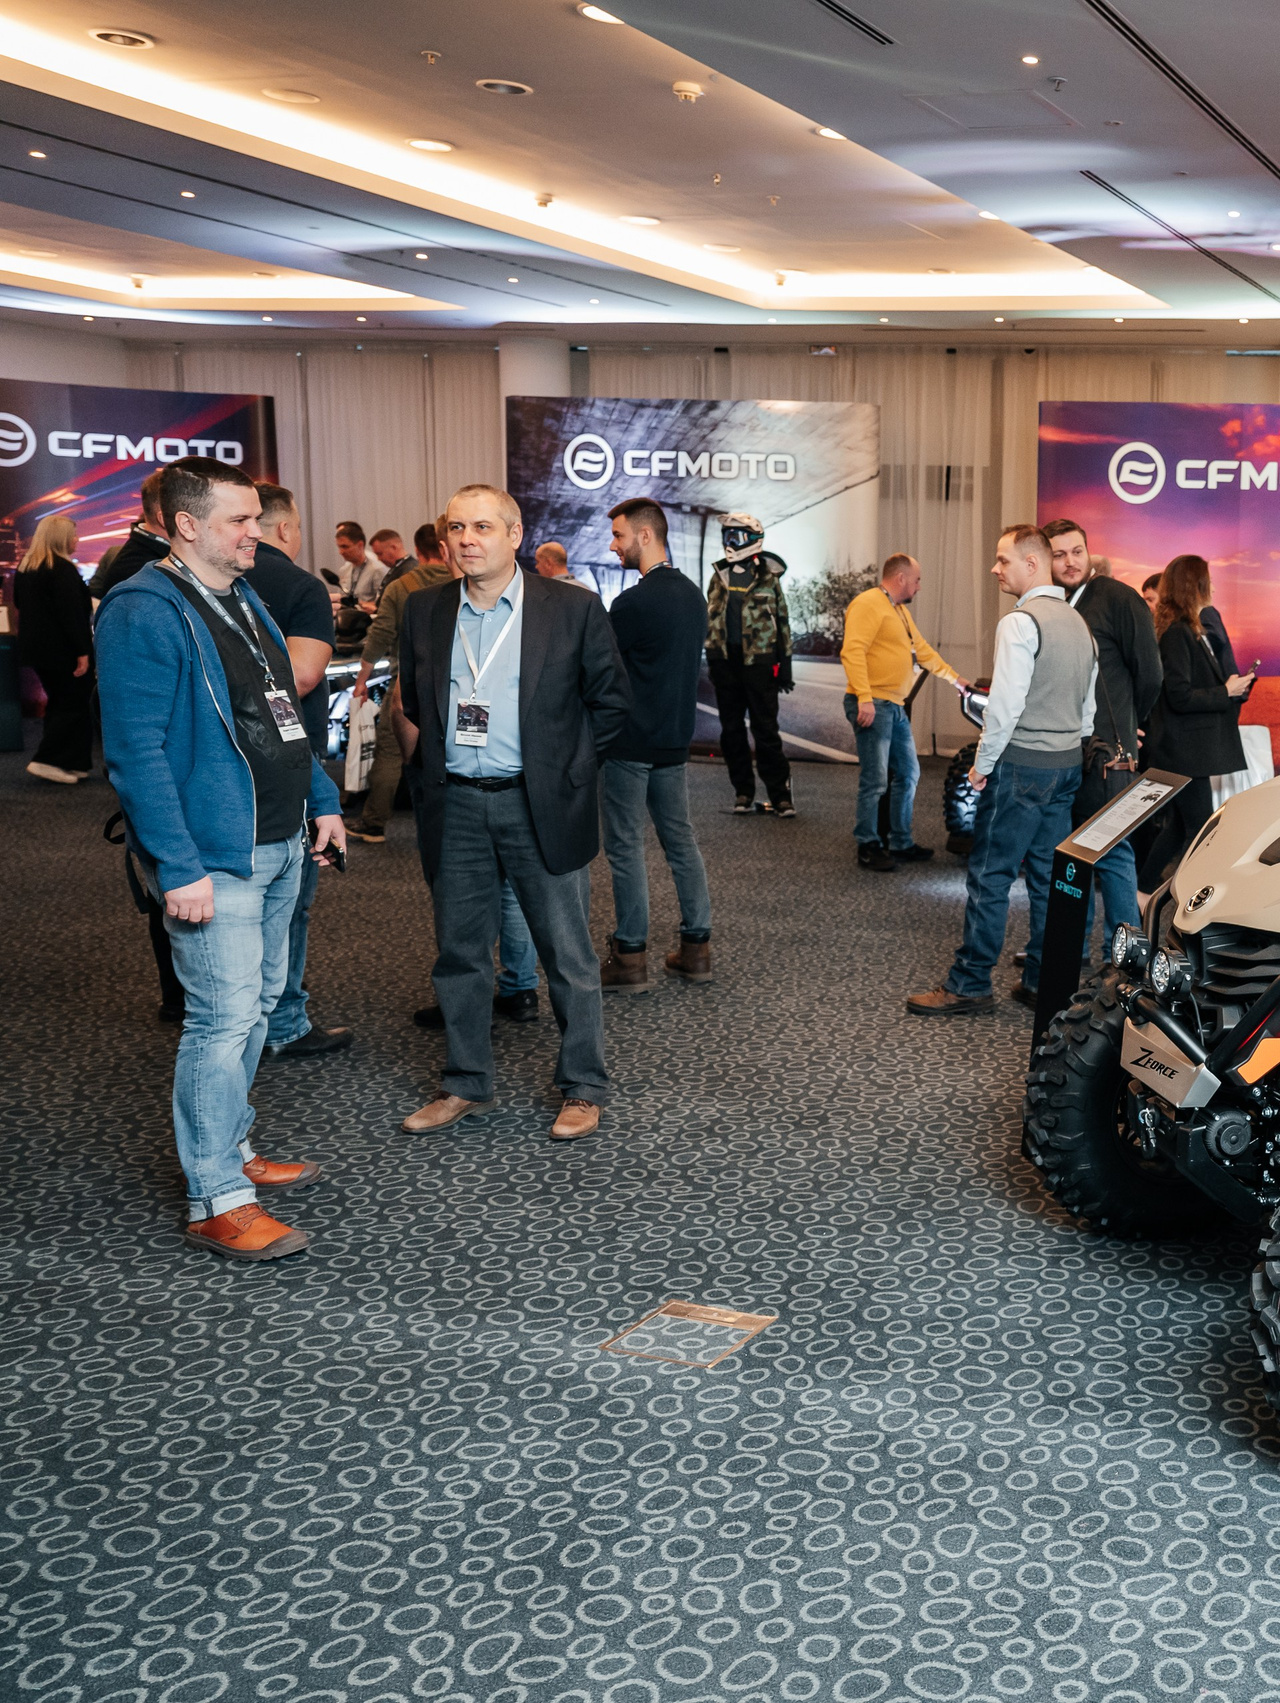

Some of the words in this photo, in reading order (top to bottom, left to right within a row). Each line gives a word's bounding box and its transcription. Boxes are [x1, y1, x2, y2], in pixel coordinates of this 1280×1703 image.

[48, 430, 244, 466] CFMOTO
[623, 449, 797, 481] CFMOTO
[1055, 880, 1083, 899] CFMOTO
[1129, 1046, 1180, 1080] ZFORCE
